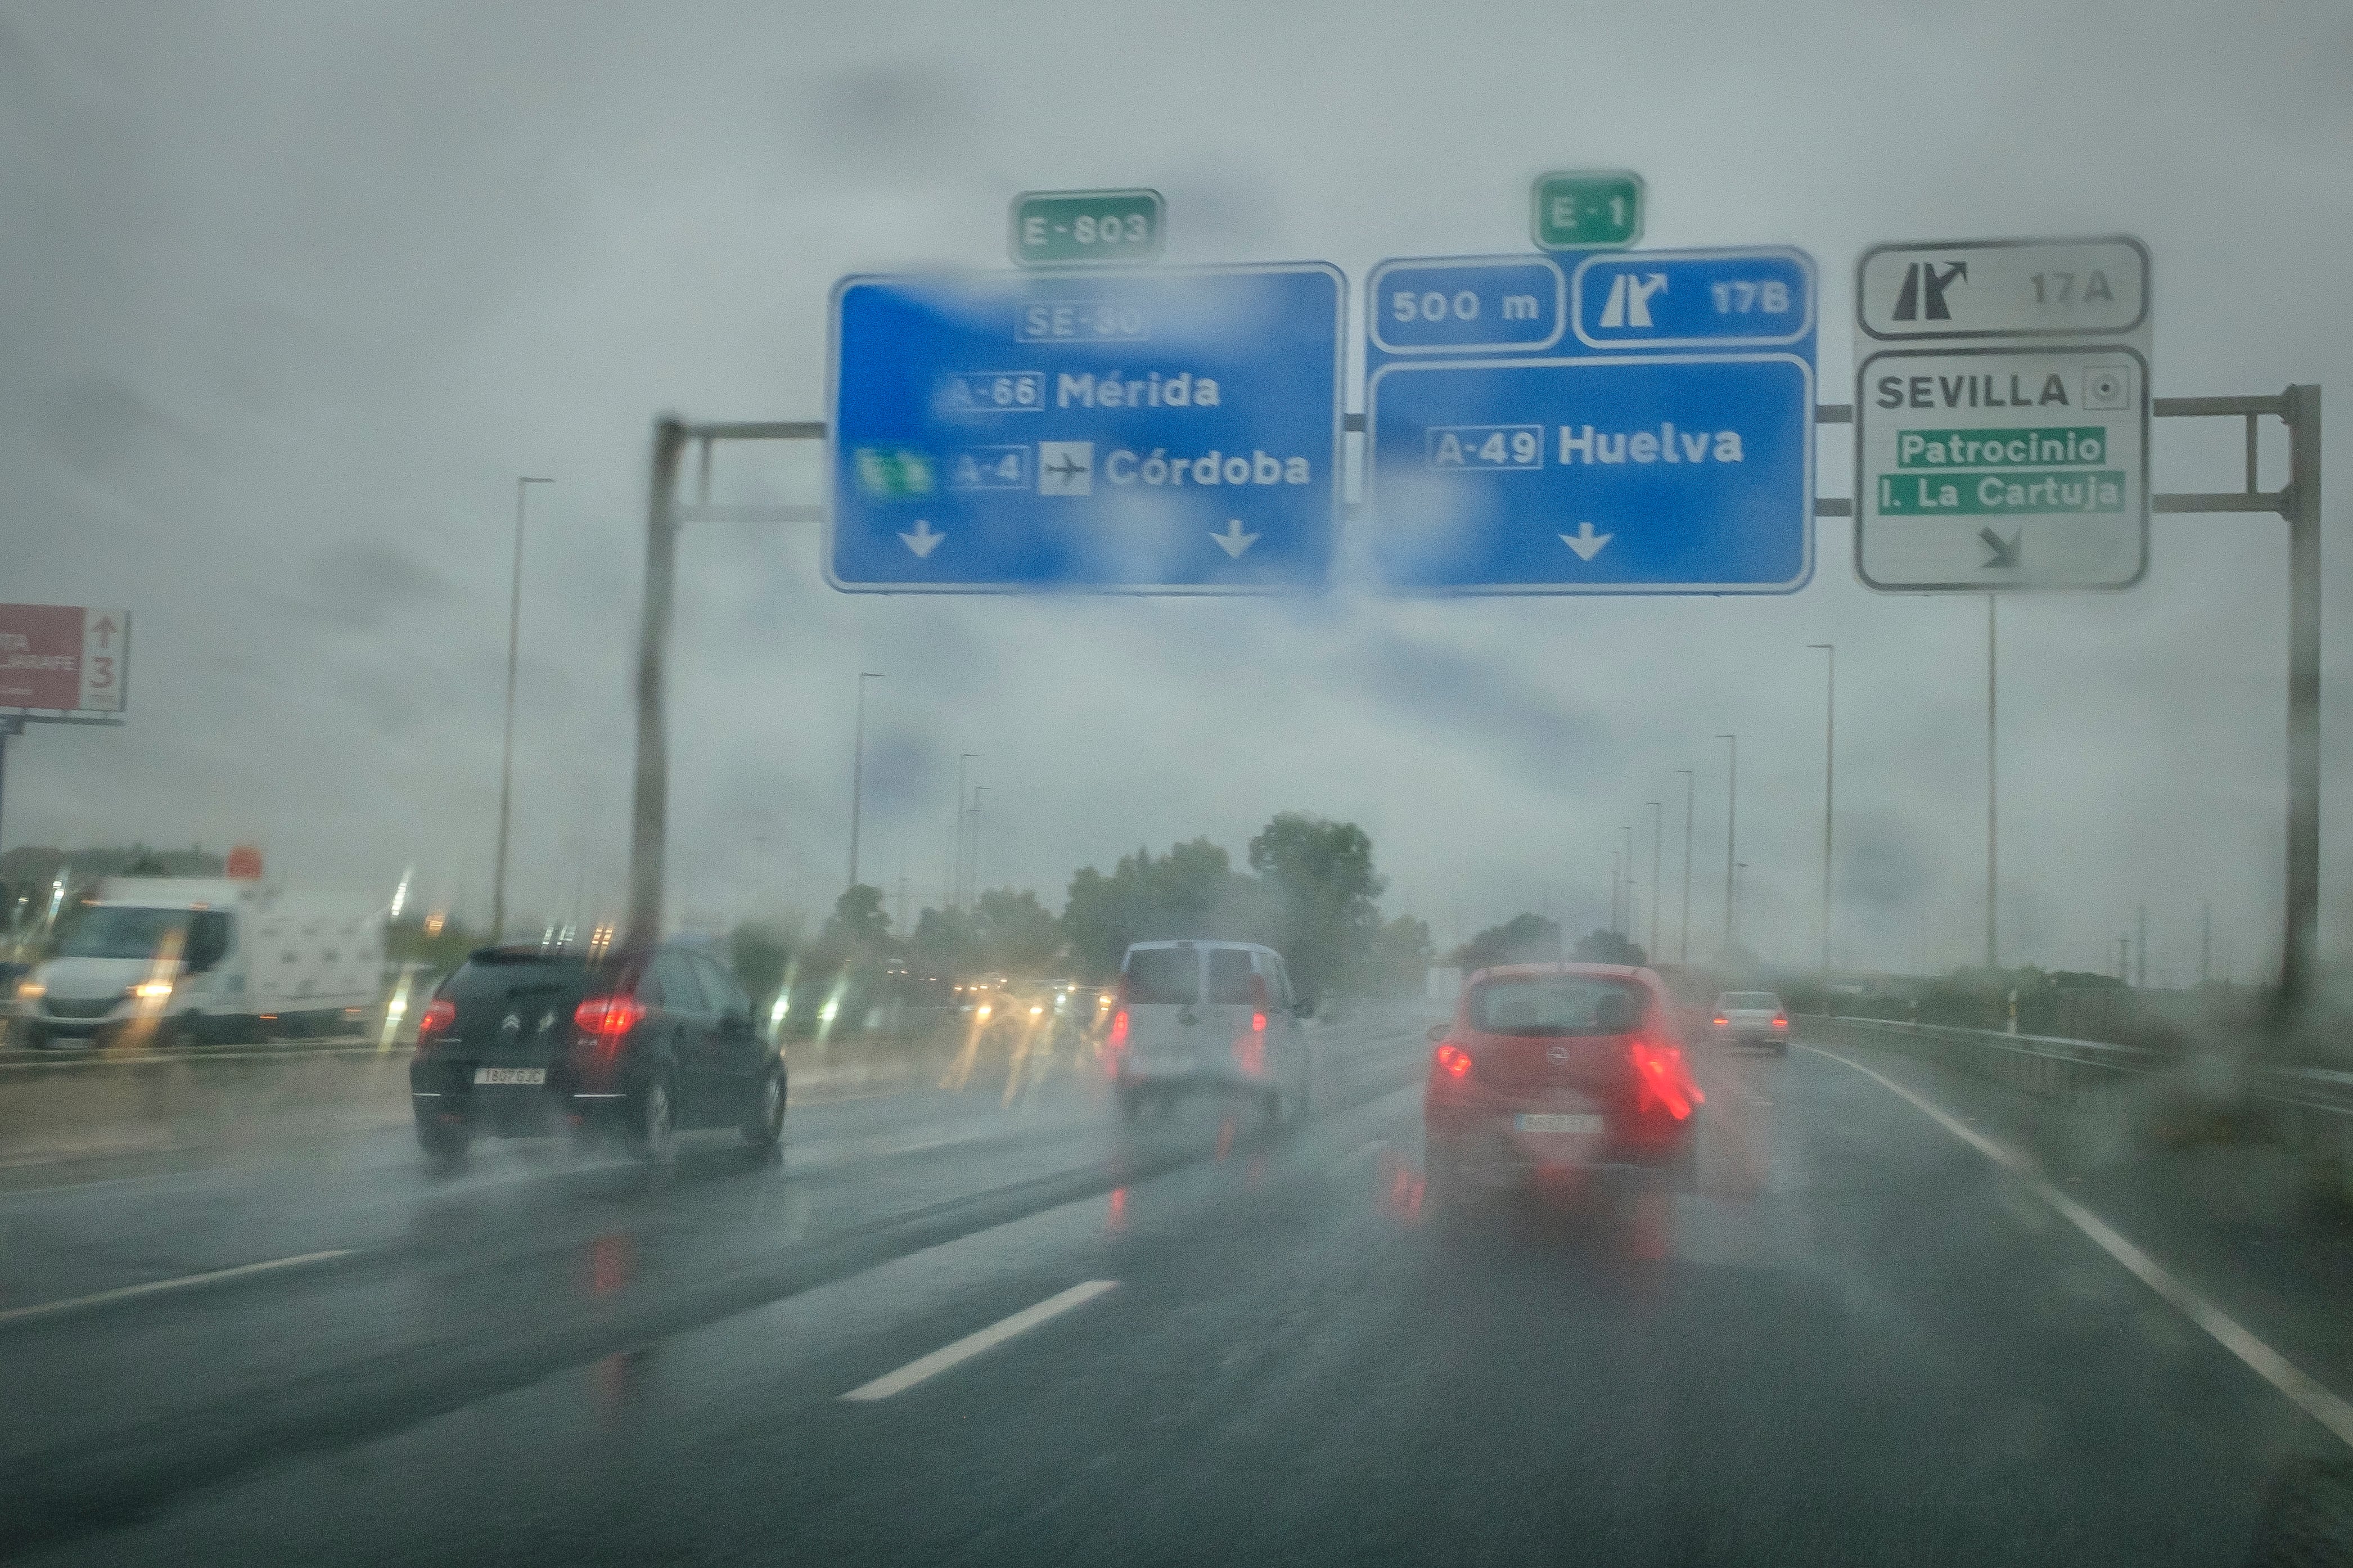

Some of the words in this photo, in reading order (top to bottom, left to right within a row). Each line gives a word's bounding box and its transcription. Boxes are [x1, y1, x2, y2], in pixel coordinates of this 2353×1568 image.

[1023, 213, 1149, 245] E-803
[1550, 197, 1625, 228] E-1
[1710, 281, 1792, 315] 17B
[2030, 270, 2115, 305] 17A
[1025, 305, 1143, 336] SE-30
[1392, 290, 1480, 323] 500
[1502, 292, 1539, 321] m
[948, 376, 1037, 407] A-66
[1057, 371, 1221, 409] Mérida
[1875, 373, 2070, 409] SEVILLA
[1435, 430, 1538, 466] A-49
[1558, 422, 1745, 465] Huelva
[1900, 431, 2104, 464] Patrocinio
[954, 453, 1020, 483] A-4
[1105, 448, 1311, 485] Córdoba
[1918, 478, 1960, 507] La
[1977, 476, 2119, 509] Cartuja
[90, 656, 115, 688] 3
